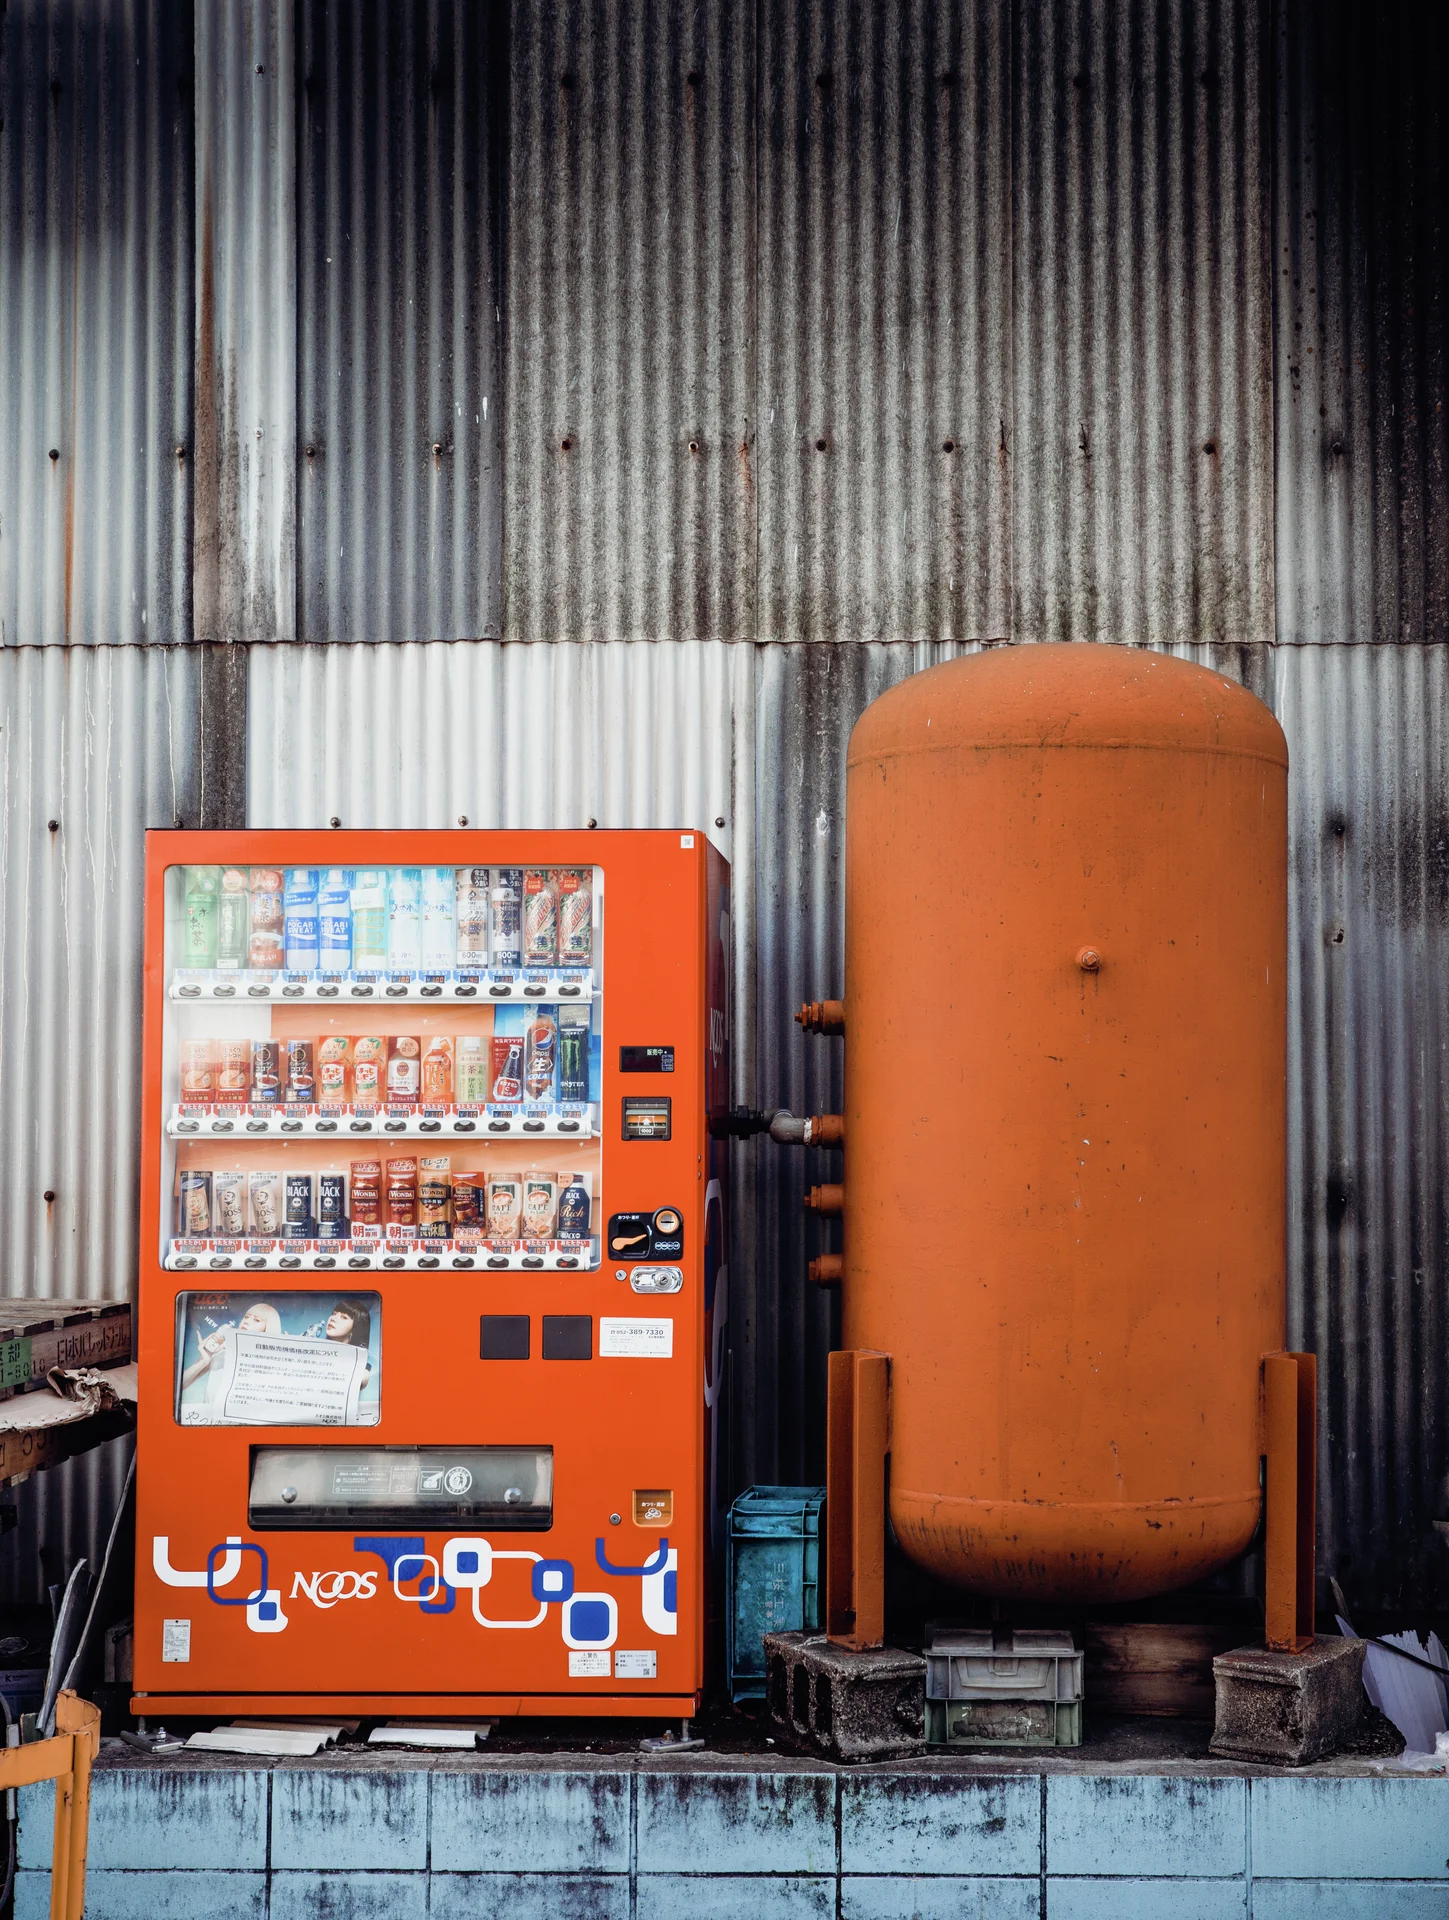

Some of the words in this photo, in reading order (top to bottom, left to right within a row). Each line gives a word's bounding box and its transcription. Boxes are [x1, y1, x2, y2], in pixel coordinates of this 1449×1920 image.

[531, 1058, 547, 1072] 生
[388, 1160, 413, 1168] おはよう
[287, 1187, 309, 1196] BLACK
[320, 1187, 340, 1196] BLACK
[223, 1207, 241, 1217] BOSS
[256, 1207, 275, 1217] BOSS
[560, 1205, 584, 1217] Rich
[353, 1226, 364, 1237] 朝
[390, 1227, 401, 1238] 朝
[204, 1316, 217, 1328] NEW
[255, 1343, 338, 1357] 自動販売機価格改定について
[289, 1571, 378, 1608] NOOS
